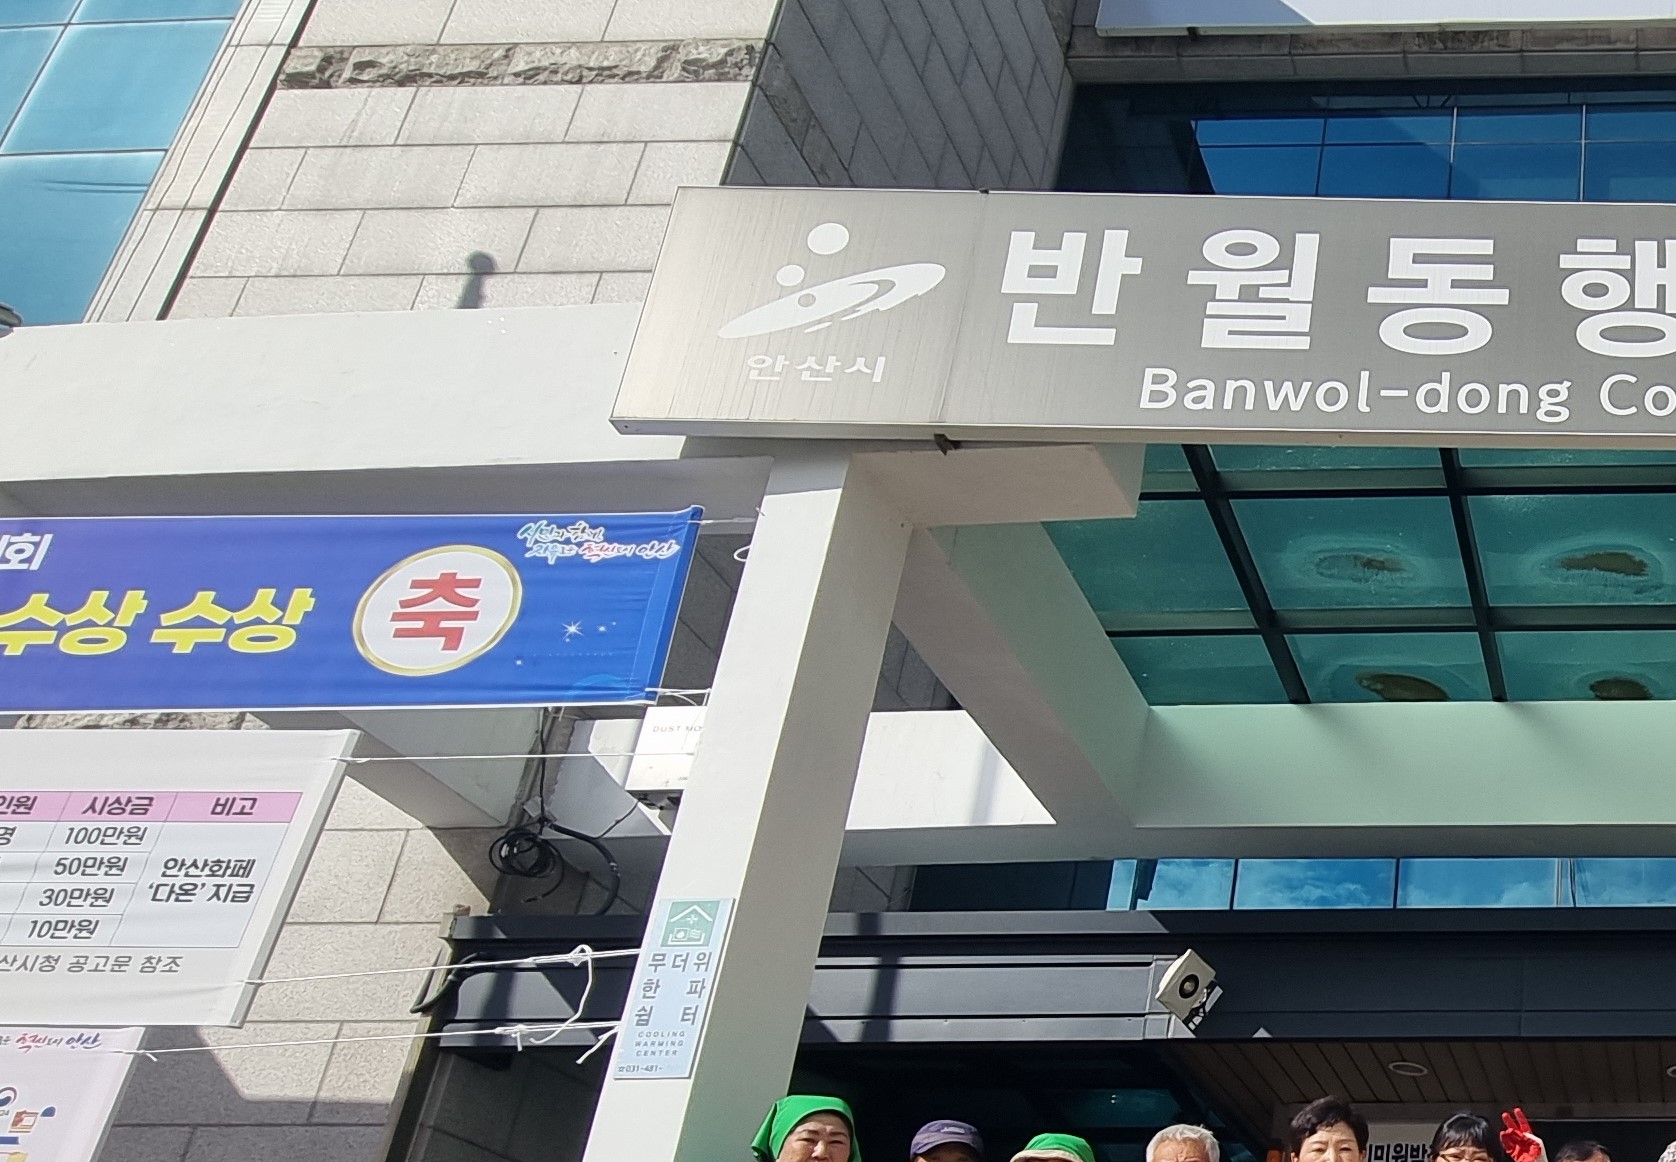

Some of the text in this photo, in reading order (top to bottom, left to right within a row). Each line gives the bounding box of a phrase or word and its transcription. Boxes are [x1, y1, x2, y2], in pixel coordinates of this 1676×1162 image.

[746, 353, 885, 384] 안산시
[1139, 366, 1573, 423] Banwol-dong
[0, 533, 53, 571] 회
[0, 588, 315, 655] 수상 수상
[390, 572, 481, 651] 축
[81, 795, 154, 816] 시상금
[210, 796, 258, 816] 비고
[64, 826, 148, 846] 100만원
[53, 856, 128, 877] 50만원
[38, 887, 115, 908] 30만원
[206, 883, 255, 903] 지급
[27, 919, 100, 940] 10만원
[67, 955, 133, 973] 공고문
[139, 955, 183, 974] 참조
[648, 951, 712, 973] 무더위
